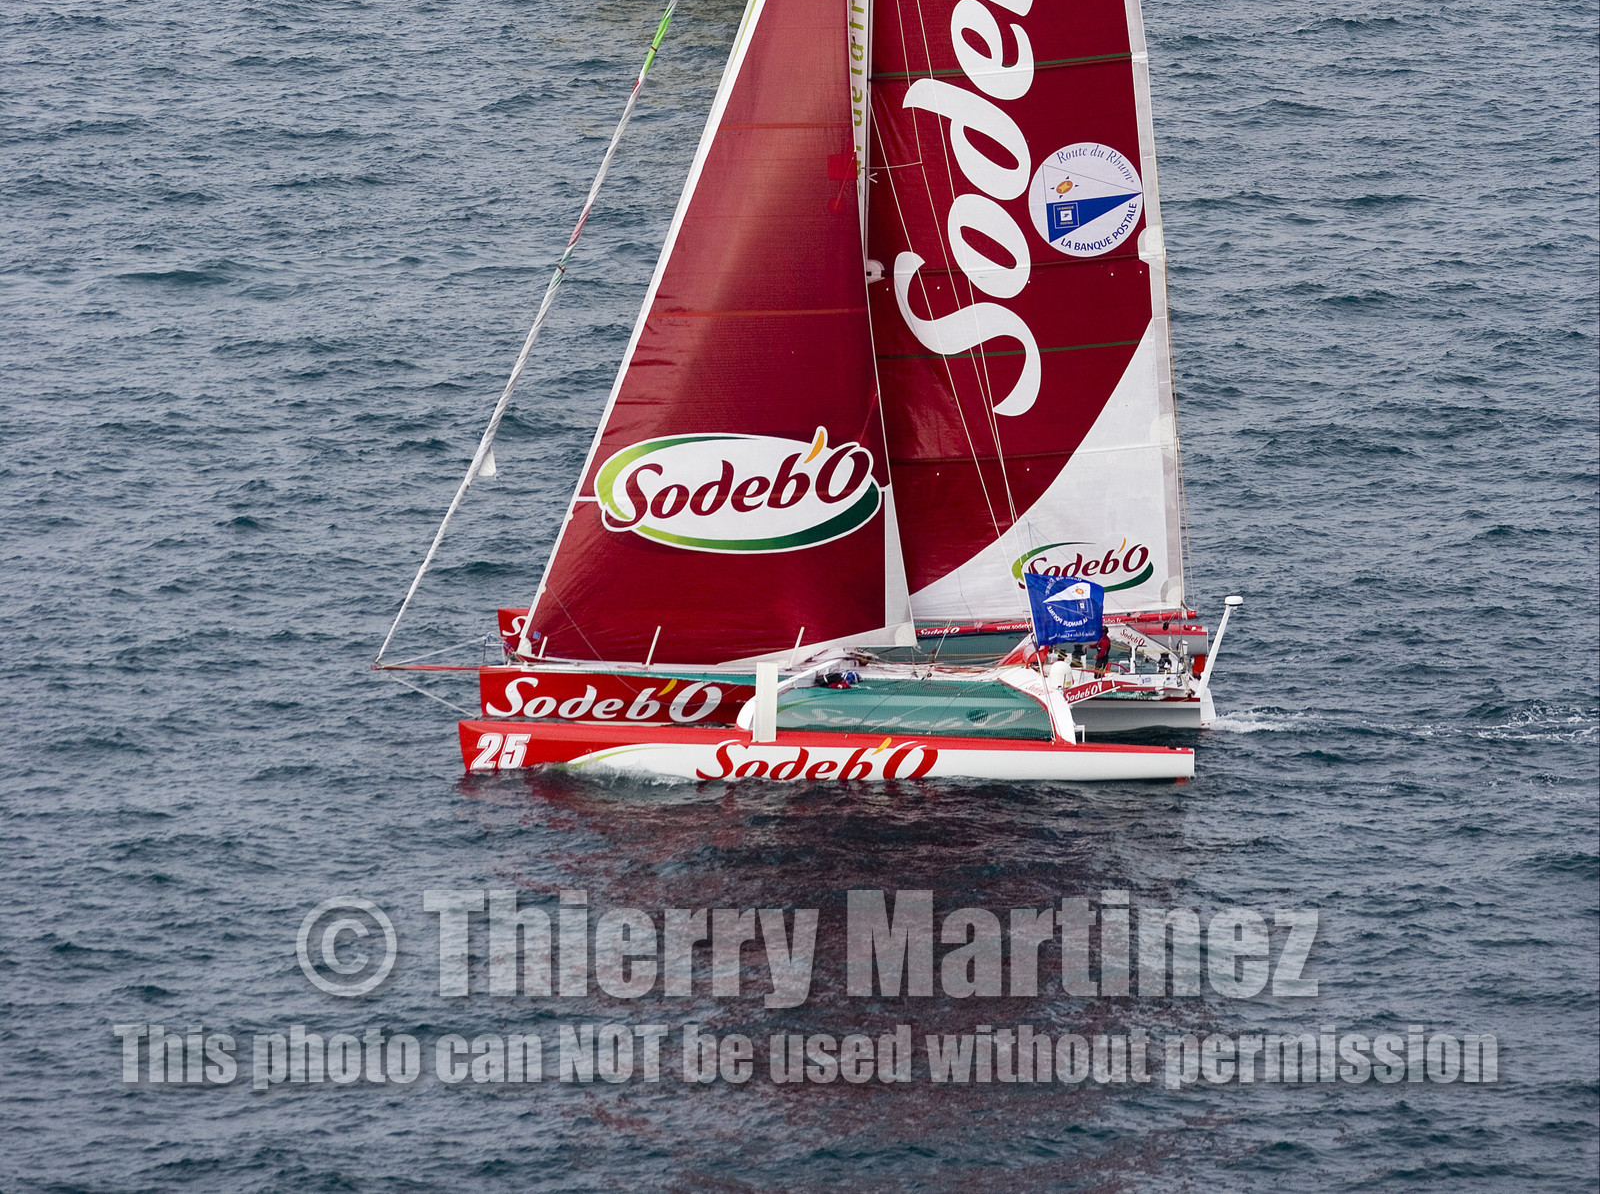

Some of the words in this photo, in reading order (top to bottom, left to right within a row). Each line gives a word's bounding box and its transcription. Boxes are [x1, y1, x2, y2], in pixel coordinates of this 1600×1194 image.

[1056, 147, 1088, 164] Route
[1089, 144, 1105, 158] du
[1060, 237, 1072, 249] LA
[1074, 235, 1113, 251] BANQUE
[1111, 202, 1138, 240] POSTALE
[604, 430, 871, 528] Sodeb'O
[486, 677, 723, 723] Sodeb'O
[470, 733, 532, 770] 25
[695, 736, 939, 780] Sodeb'O
